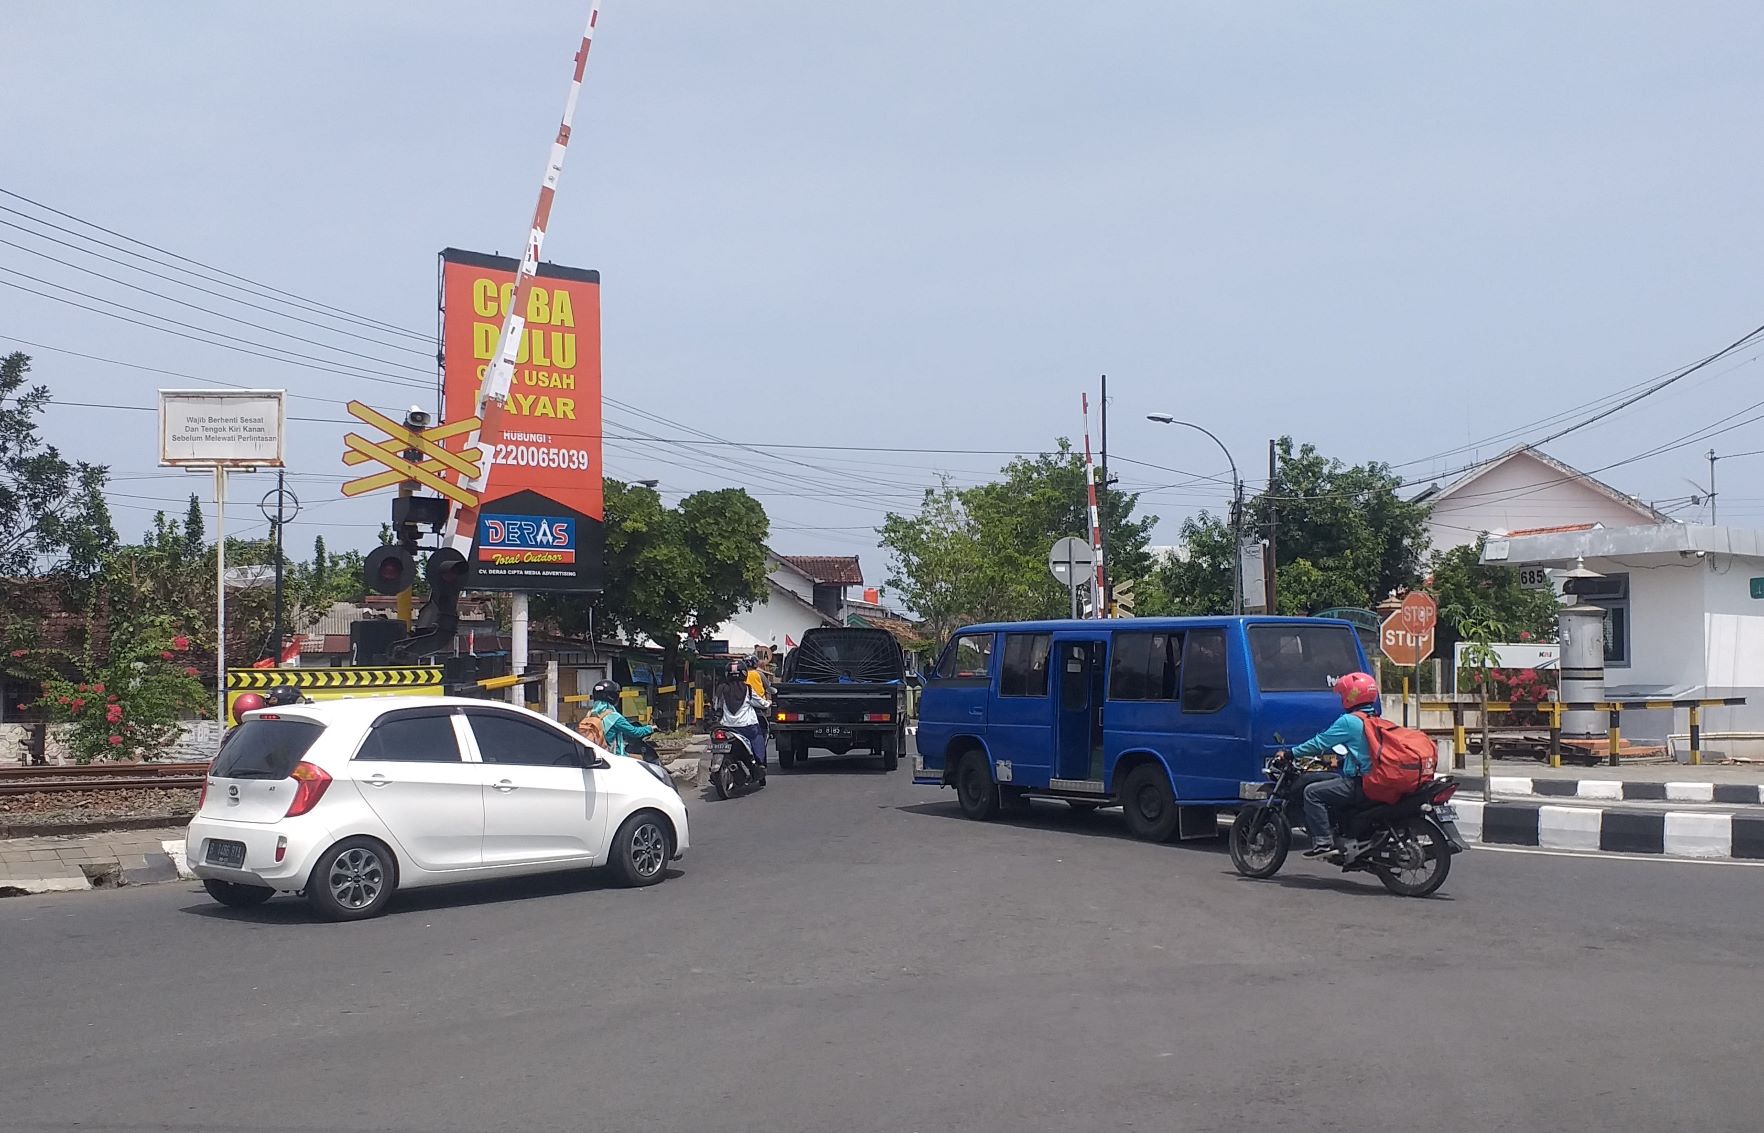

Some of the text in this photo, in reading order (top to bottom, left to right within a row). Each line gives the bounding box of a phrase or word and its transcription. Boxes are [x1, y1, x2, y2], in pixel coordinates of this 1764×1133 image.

[524, 369, 575, 390] USAH
[474, 389, 577, 420] AYAR
[186, 416, 264, 425] Wajib Berhenti Sesaat
[171, 434, 277, 442] Sebelum Melewati Perlintasan
[184, 425, 265, 434] Dan Tengok Kiri Kanan
[503, 431, 546, 443] HUBUNGI
[491, 444, 589, 470] 220065039
[484, 518, 569, 546] DERAS
[492, 551, 563, 566] Total Outdoor
[1520, 569, 1543, 585] 685
[1403, 605, 1434, 623] STOP
[352, 642, 358, 665] 2
